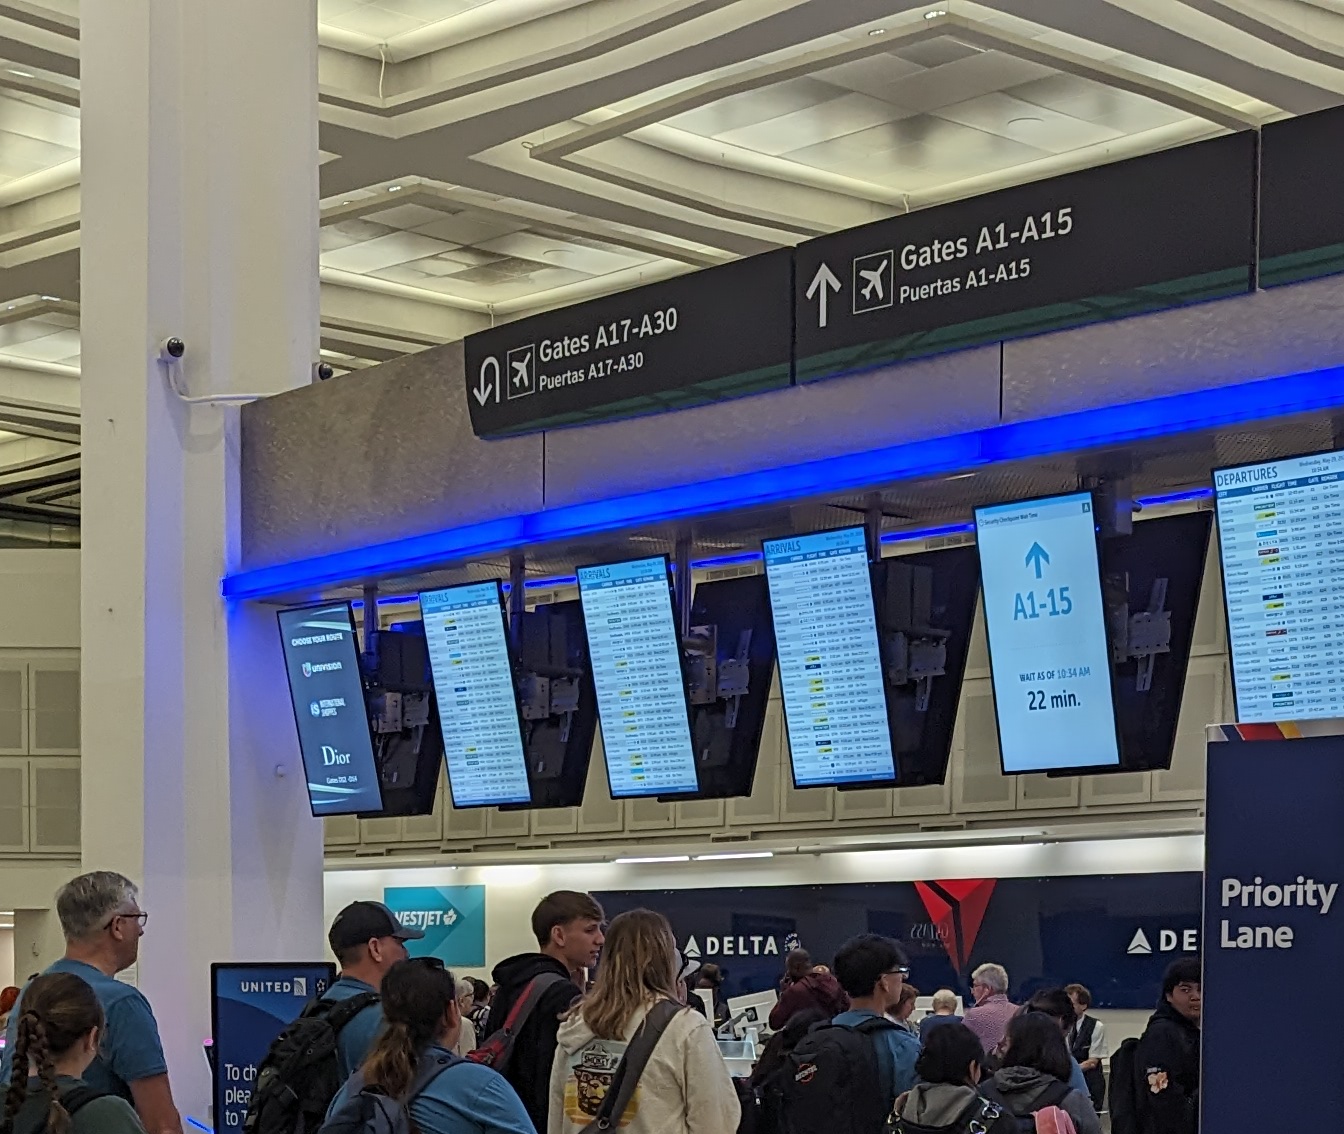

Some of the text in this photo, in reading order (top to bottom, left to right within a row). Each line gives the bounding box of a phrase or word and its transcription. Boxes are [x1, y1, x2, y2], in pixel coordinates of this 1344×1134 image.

[899, 207, 1074, 272] Gates A1-A15
[899, 258, 1031, 304] Puertas A1-A15
[539, 307, 678, 363] Gates A17-A30
[539, 352, 644, 392] Puertas A17-A30
[1216, 466, 1278, 487] DEPARTURES
[766, 540, 801, 555] ARRIVALS
[580, 568, 611, 580] ARRIVALS
[1013, 586, 1073, 621] A1-15
[292, 637, 312, 646] CHOOSE
[1019, 666, 1091, 682] WAIT AS OF 10:34 AM
[1027, 690, 1081, 711] 22 min.
[321, 746, 350, 765] Dior
[1220, 876, 1338, 915] Priority
[1219, 919, 1294, 950] Lane
[706, 936, 778, 955] DELTA
[241, 981, 291, 993] UNITED
[225, 1063, 240, 1081] To
[226, 1110, 239, 1126] to
